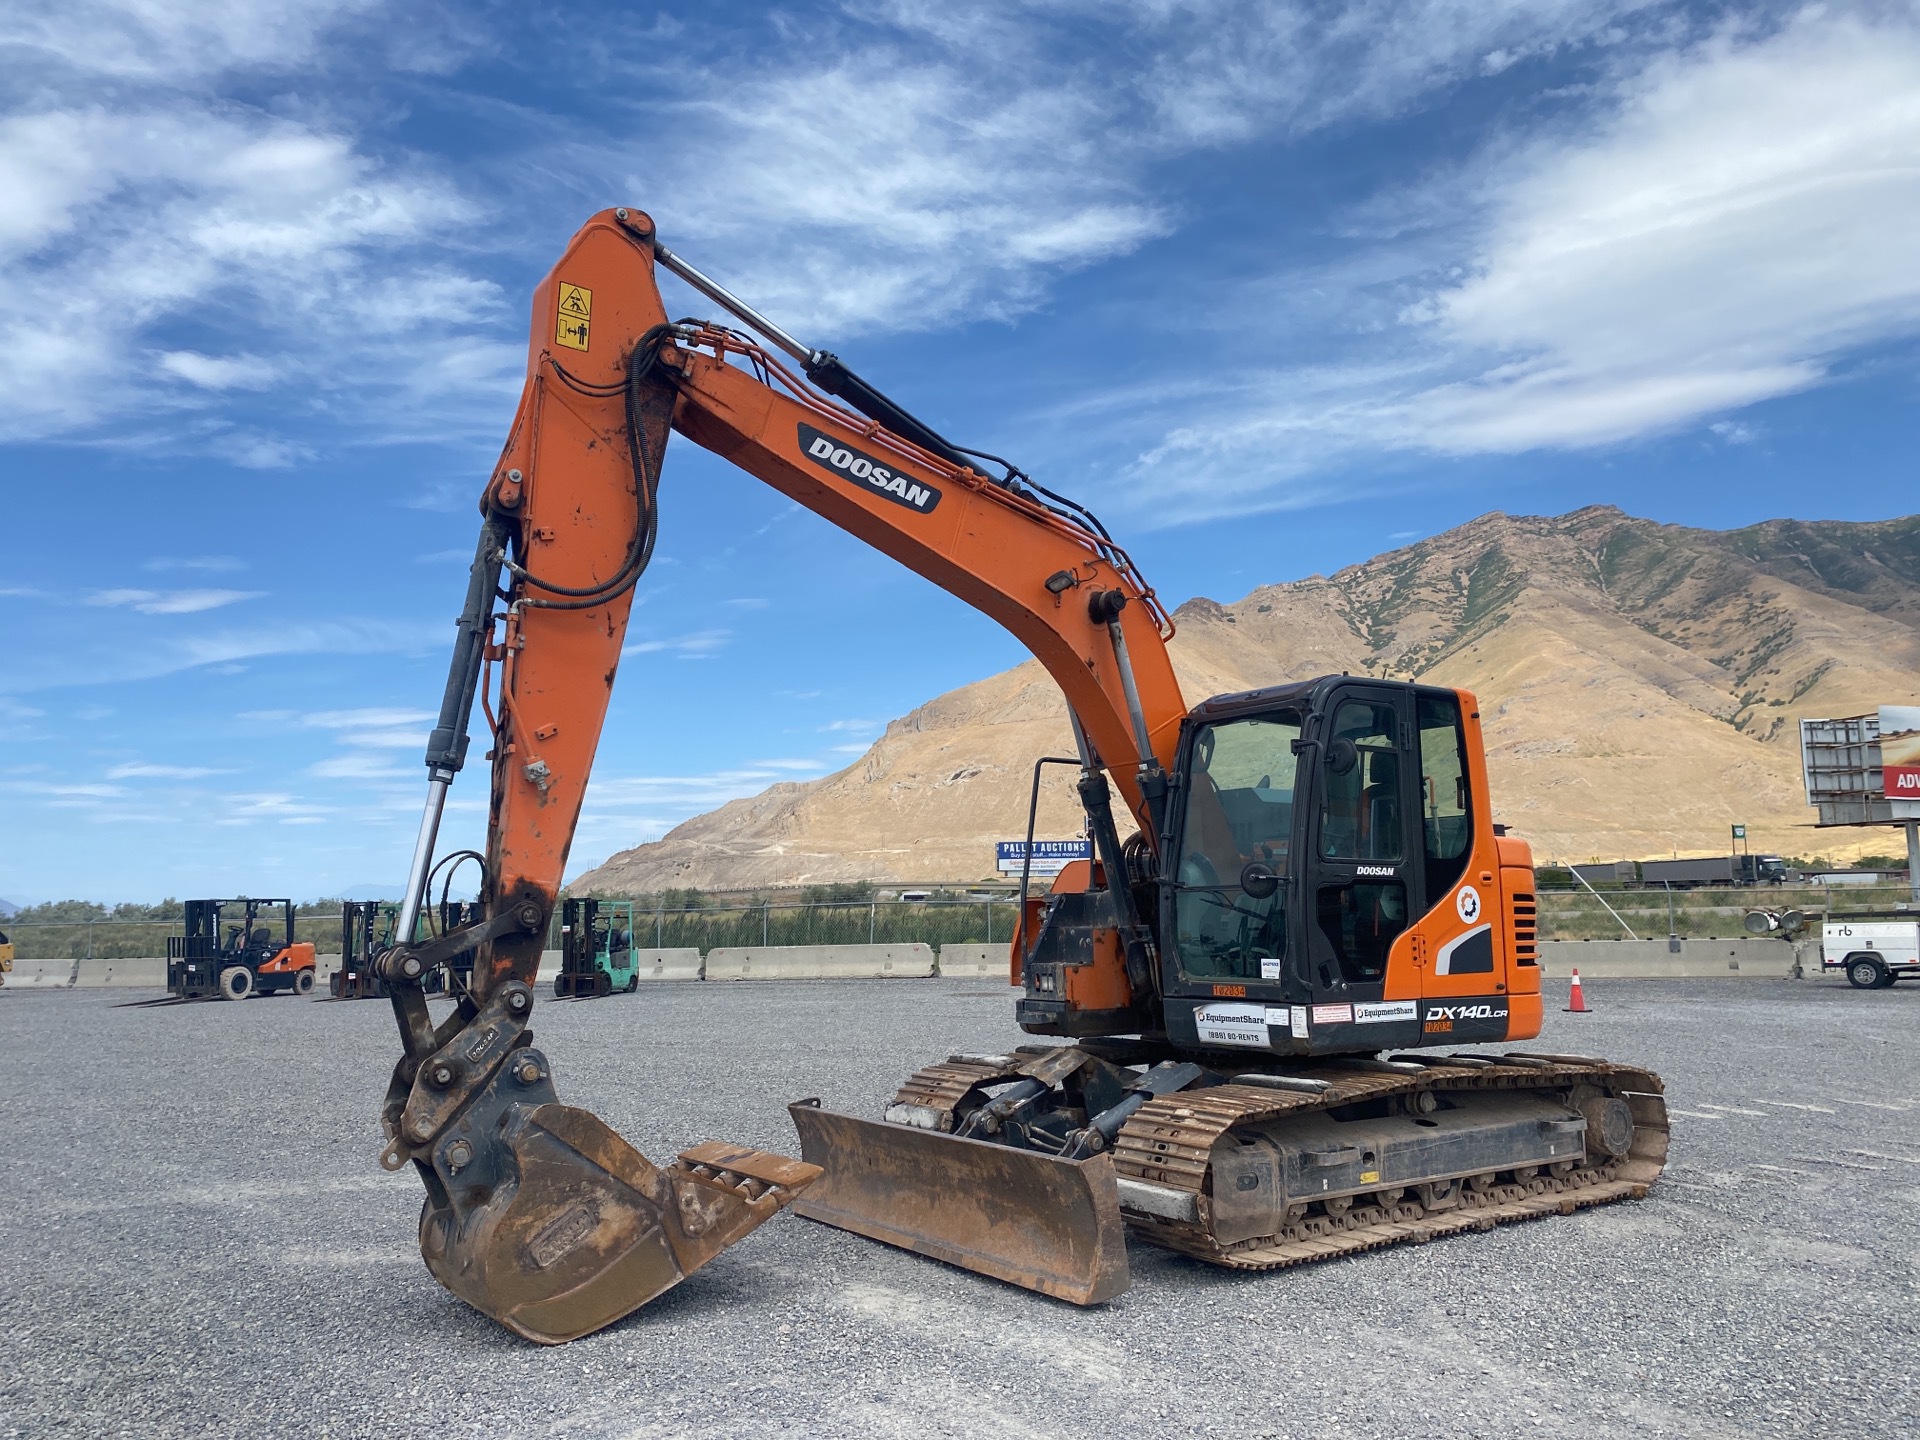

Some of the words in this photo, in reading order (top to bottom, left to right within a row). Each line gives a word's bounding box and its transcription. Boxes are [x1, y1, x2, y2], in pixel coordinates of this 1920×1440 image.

[808, 436, 931, 507] DOOSAN
[1004, 843, 1037, 852] PALLT
[1041, 843, 1085, 852] AUCTIONS
[1356, 866, 1395, 876] DOOSAN
[1838, 925, 1853, 936] rb
[1214, 986, 1245, 997] 102034
[1364, 1006, 1414, 1018] EquipmentShare
[1205, 1013, 1265, 1025] EquipmentShare
[1208, 1031, 1227, 1040] (888)
